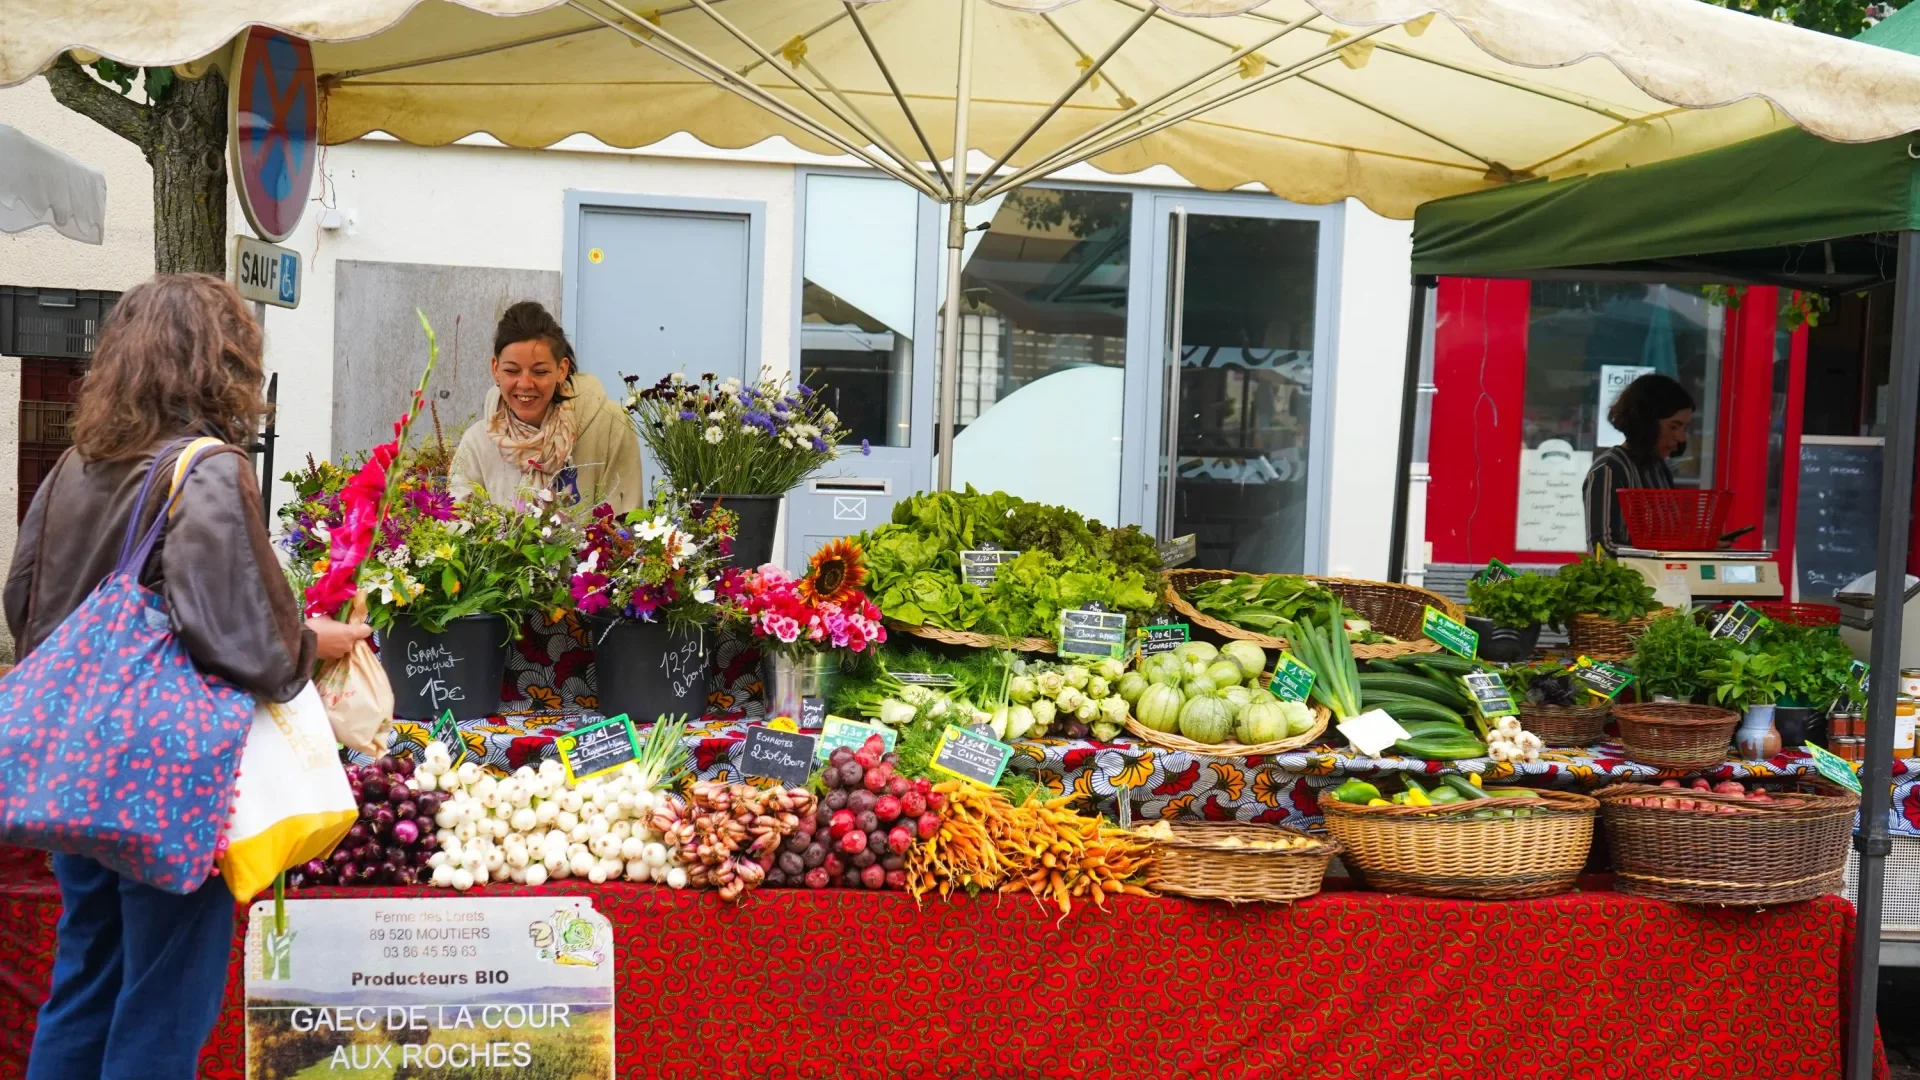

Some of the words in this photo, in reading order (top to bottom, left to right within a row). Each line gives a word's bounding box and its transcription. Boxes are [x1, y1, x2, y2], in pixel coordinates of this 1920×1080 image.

[241, 251, 278, 290] SAUF
[659, 640, 698, 679] 12,50
[419, 677, 466, 710] 15€
[672, 681, 688, 698] le
[375, 911, 416, 923] Ferme
[420, 911, 442, 922] des
[445, 910, 485, 922] Lorets
[369, 928, 386, 941] 89
[389, 928, 413, 941] 520
[416, 927, 491, 940] MOUTIERS
[383, 946, 399, 958] 03
[403, 946, 418, 958] 86
[422, 946, 438, 957] 45
[441, 945, 458, 957] 59
[461, 945, 477, 957] 63
[351, 971, 469, 987] Producteurs
[475, 970, 509, 985] BIO
[290, 1006, 376, 1033] GAEC
[388, 1006, 430, 1031] DE
[438, 1005, 475, 1030] LA
[481, 1004, 571, 1030] COUR
[329, 1043, 393, 1070] AUX
[402, 1042, 532, 1069] ROCHES
